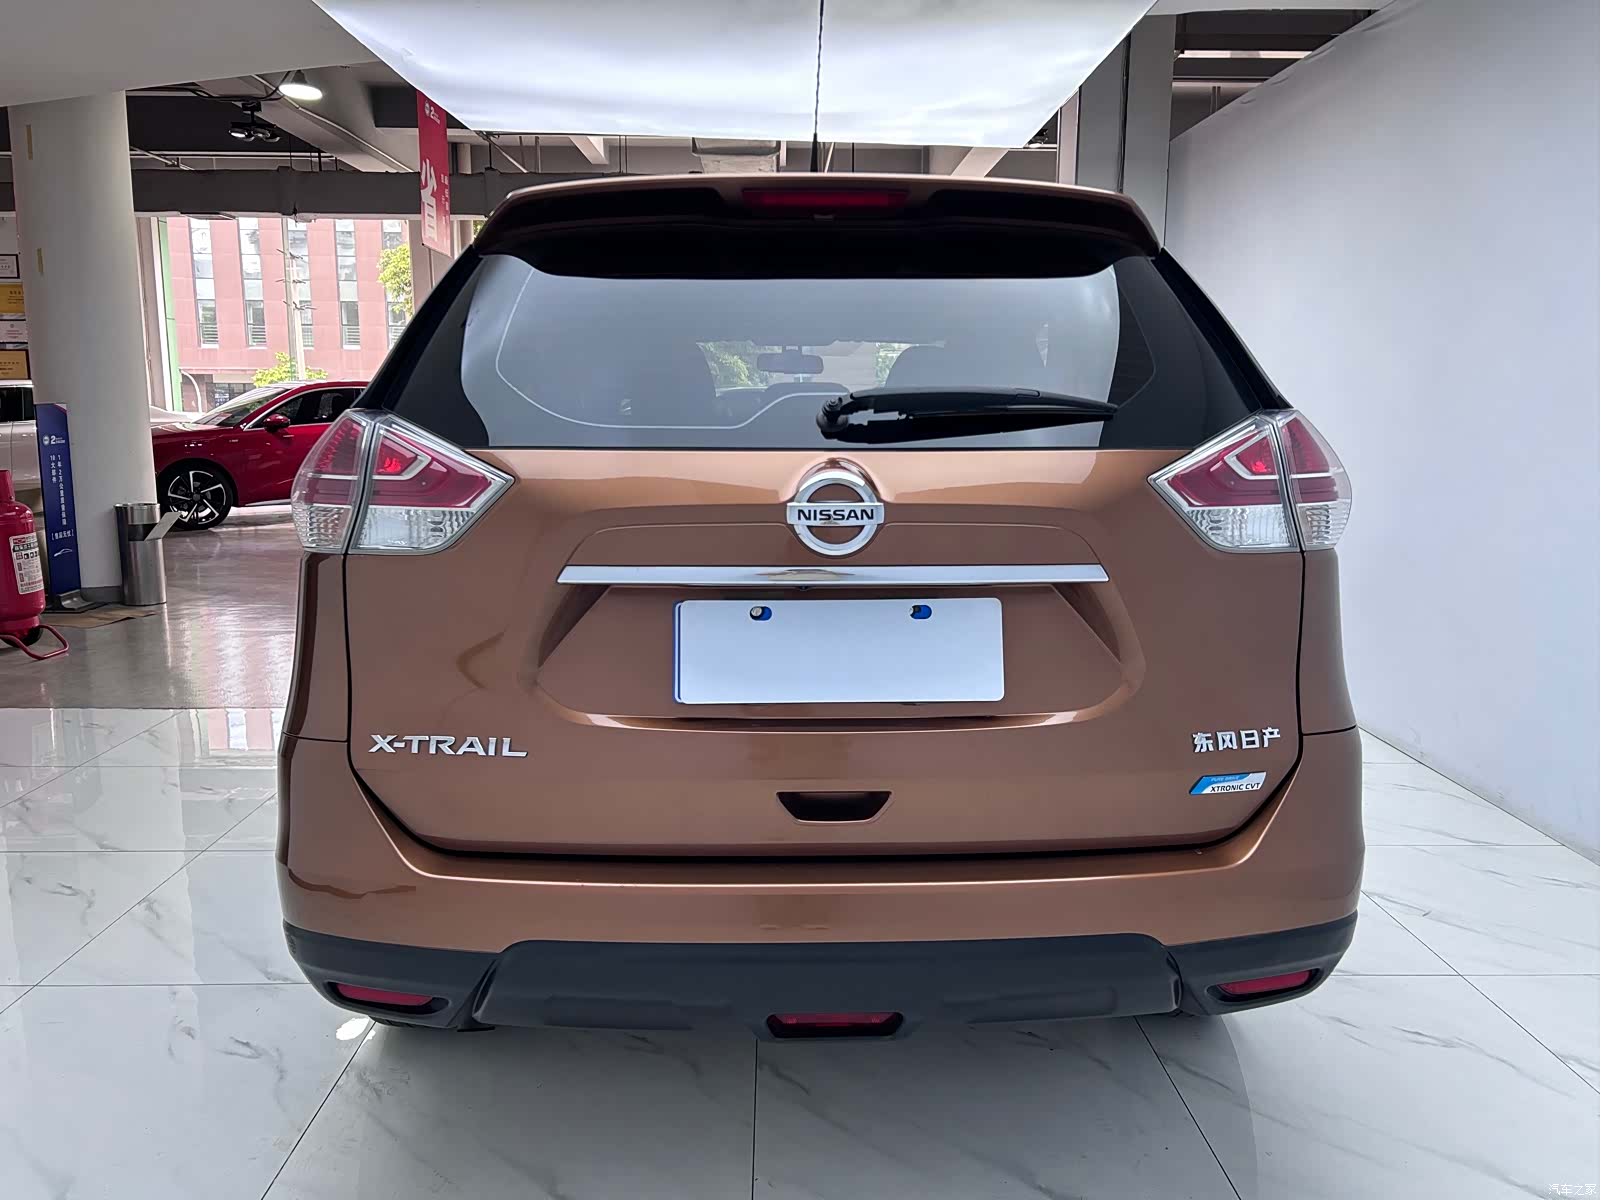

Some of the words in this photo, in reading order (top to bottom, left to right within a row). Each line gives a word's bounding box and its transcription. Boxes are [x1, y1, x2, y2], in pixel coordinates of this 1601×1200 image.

[797, 508, 874, 521] NISSAN
[368, 734, 528, 757] X-TRAIL
[1192, 726, 1281, 753] 东风日产
[1210, 784, 1244, 793] XTRONIC
